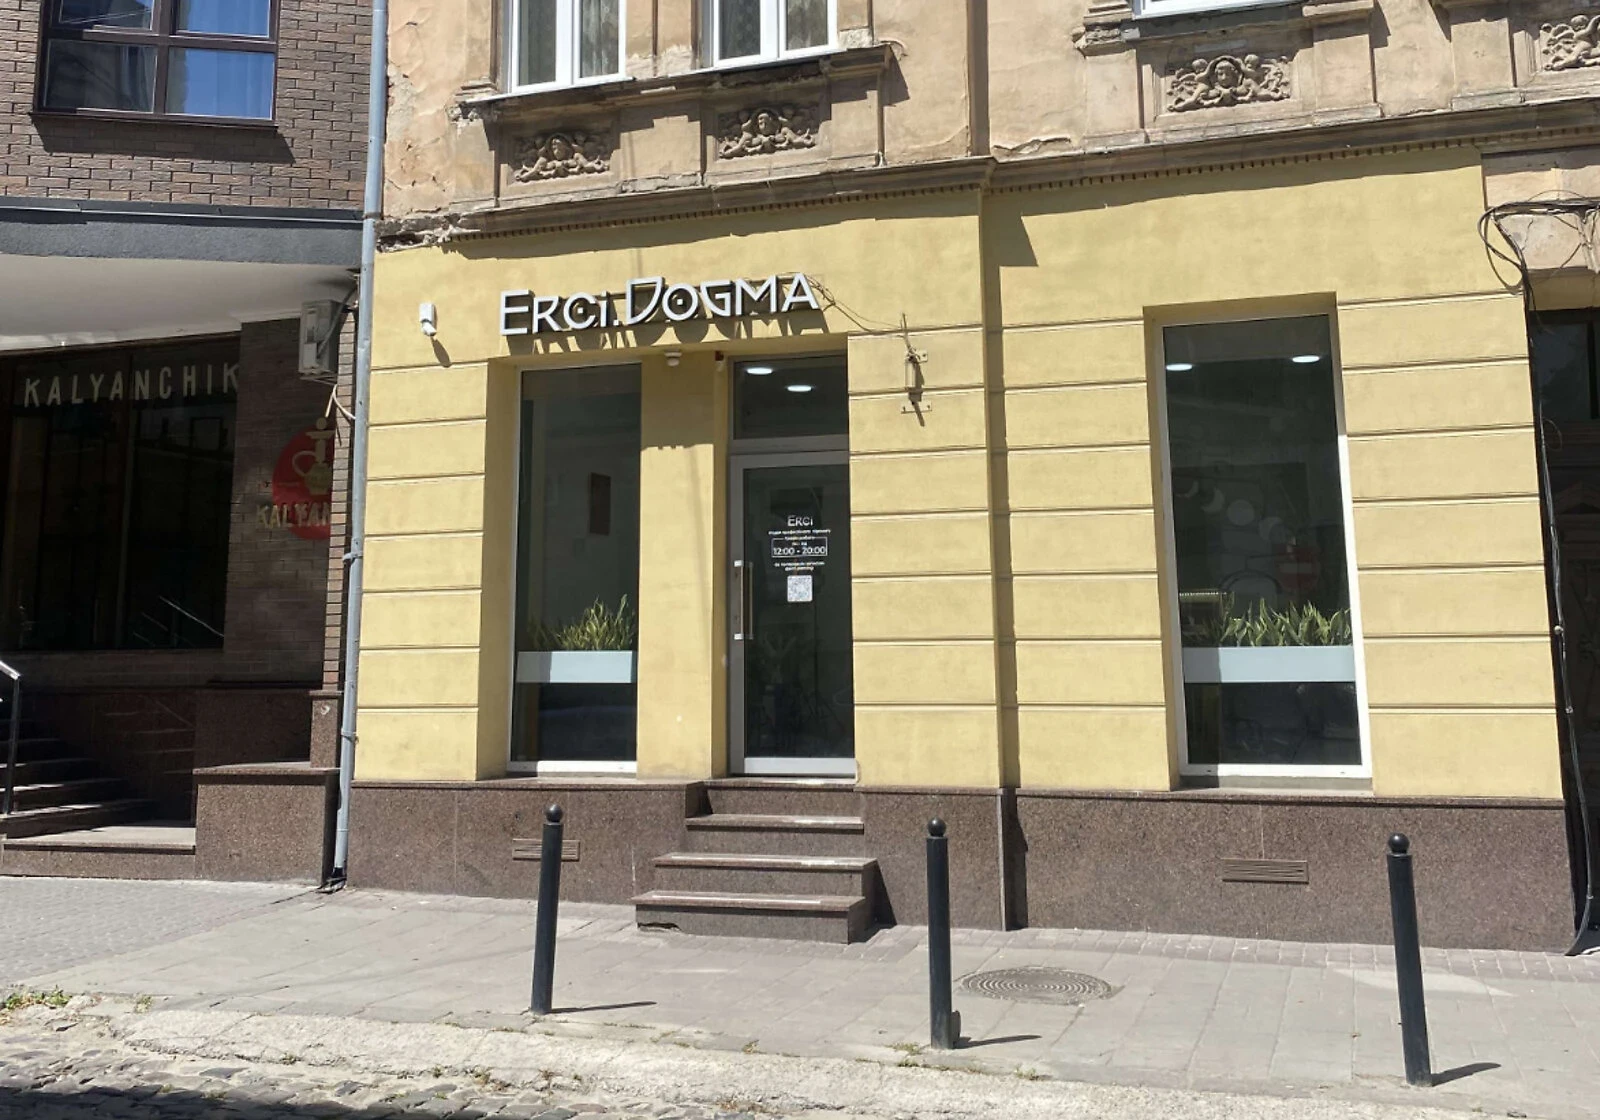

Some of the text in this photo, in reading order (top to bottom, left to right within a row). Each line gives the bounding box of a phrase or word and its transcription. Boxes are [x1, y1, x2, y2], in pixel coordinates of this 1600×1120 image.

[24, 363, 238, 408] KALYANCHIK
[773, 547, 795, 555] 12:00
[802, 546, 825, 554] 20:00
